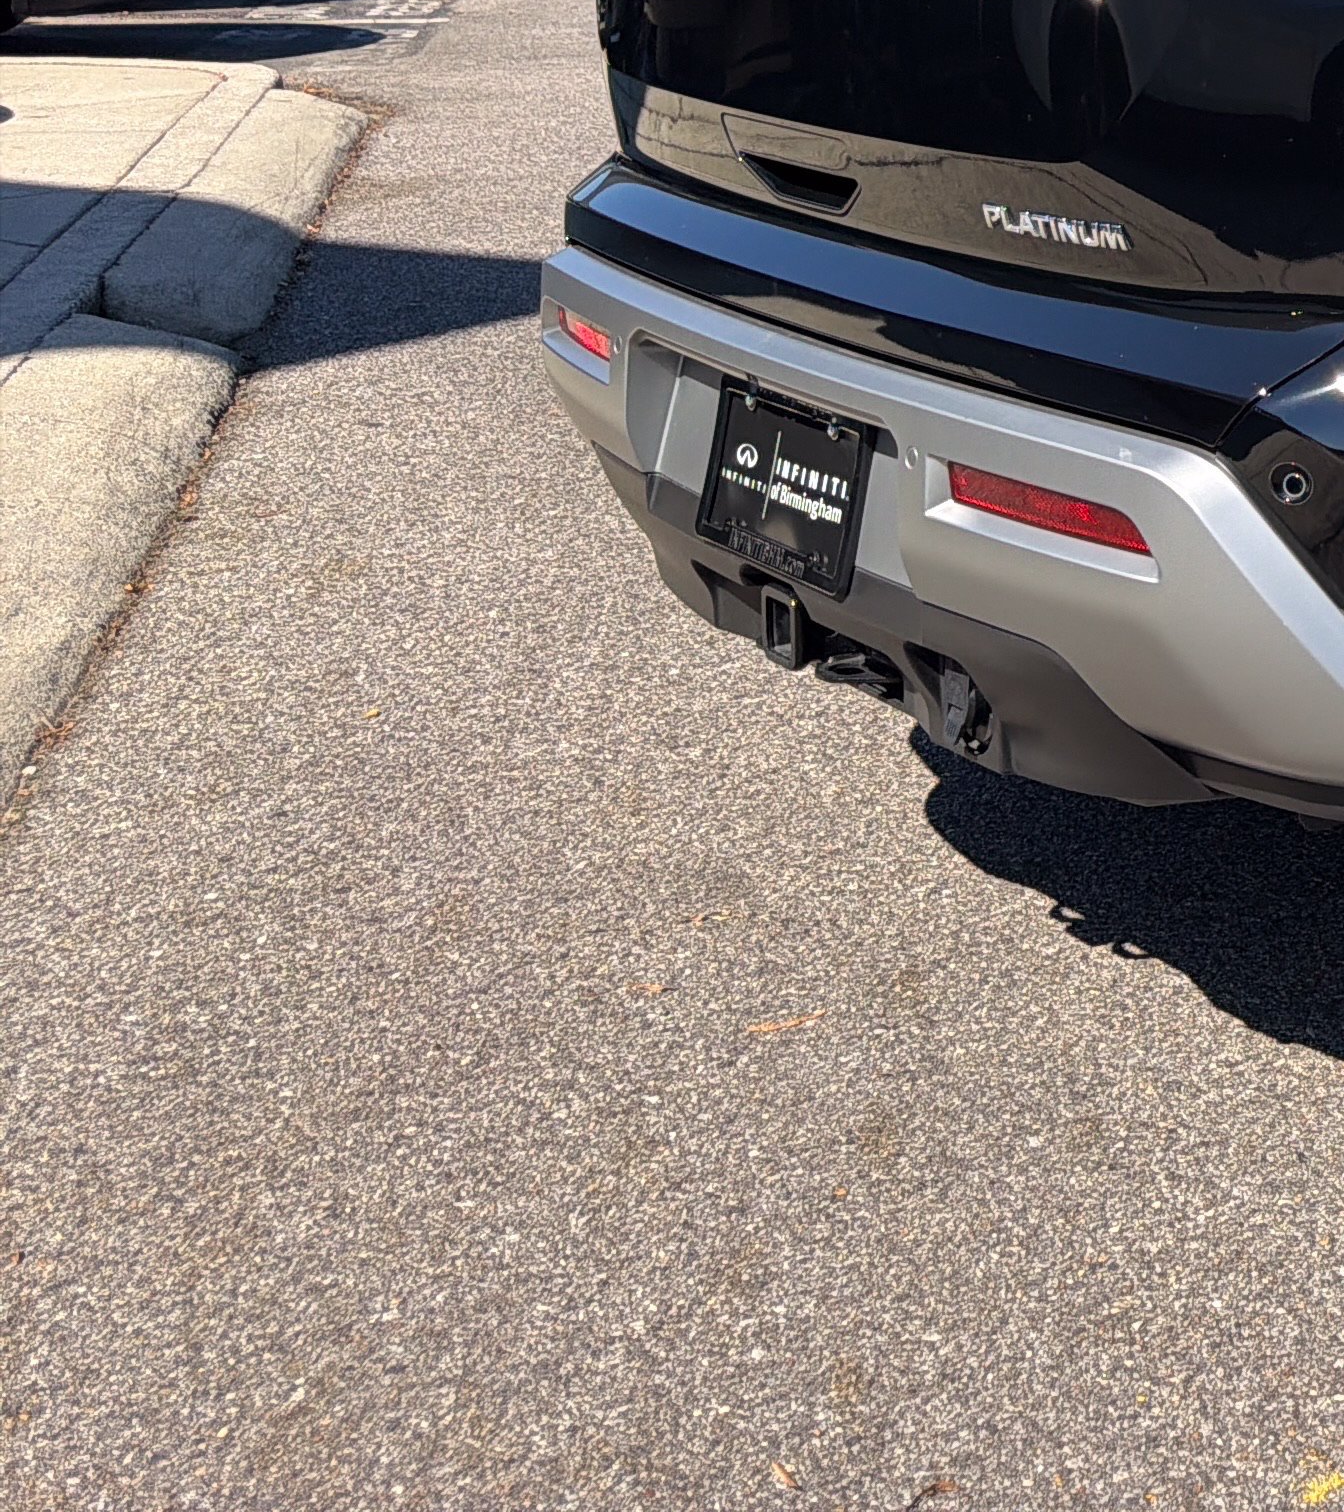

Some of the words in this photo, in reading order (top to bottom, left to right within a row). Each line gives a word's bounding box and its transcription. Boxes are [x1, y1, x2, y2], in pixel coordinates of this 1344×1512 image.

[981, 202, 1132, 252] PLATINUM
[721, 467, 767, 494] INFINITI
[775, 457, 849, 501] INFINITI
[770, 481, 782, 500] of
[779, 485, 843, 524] Birmingham
